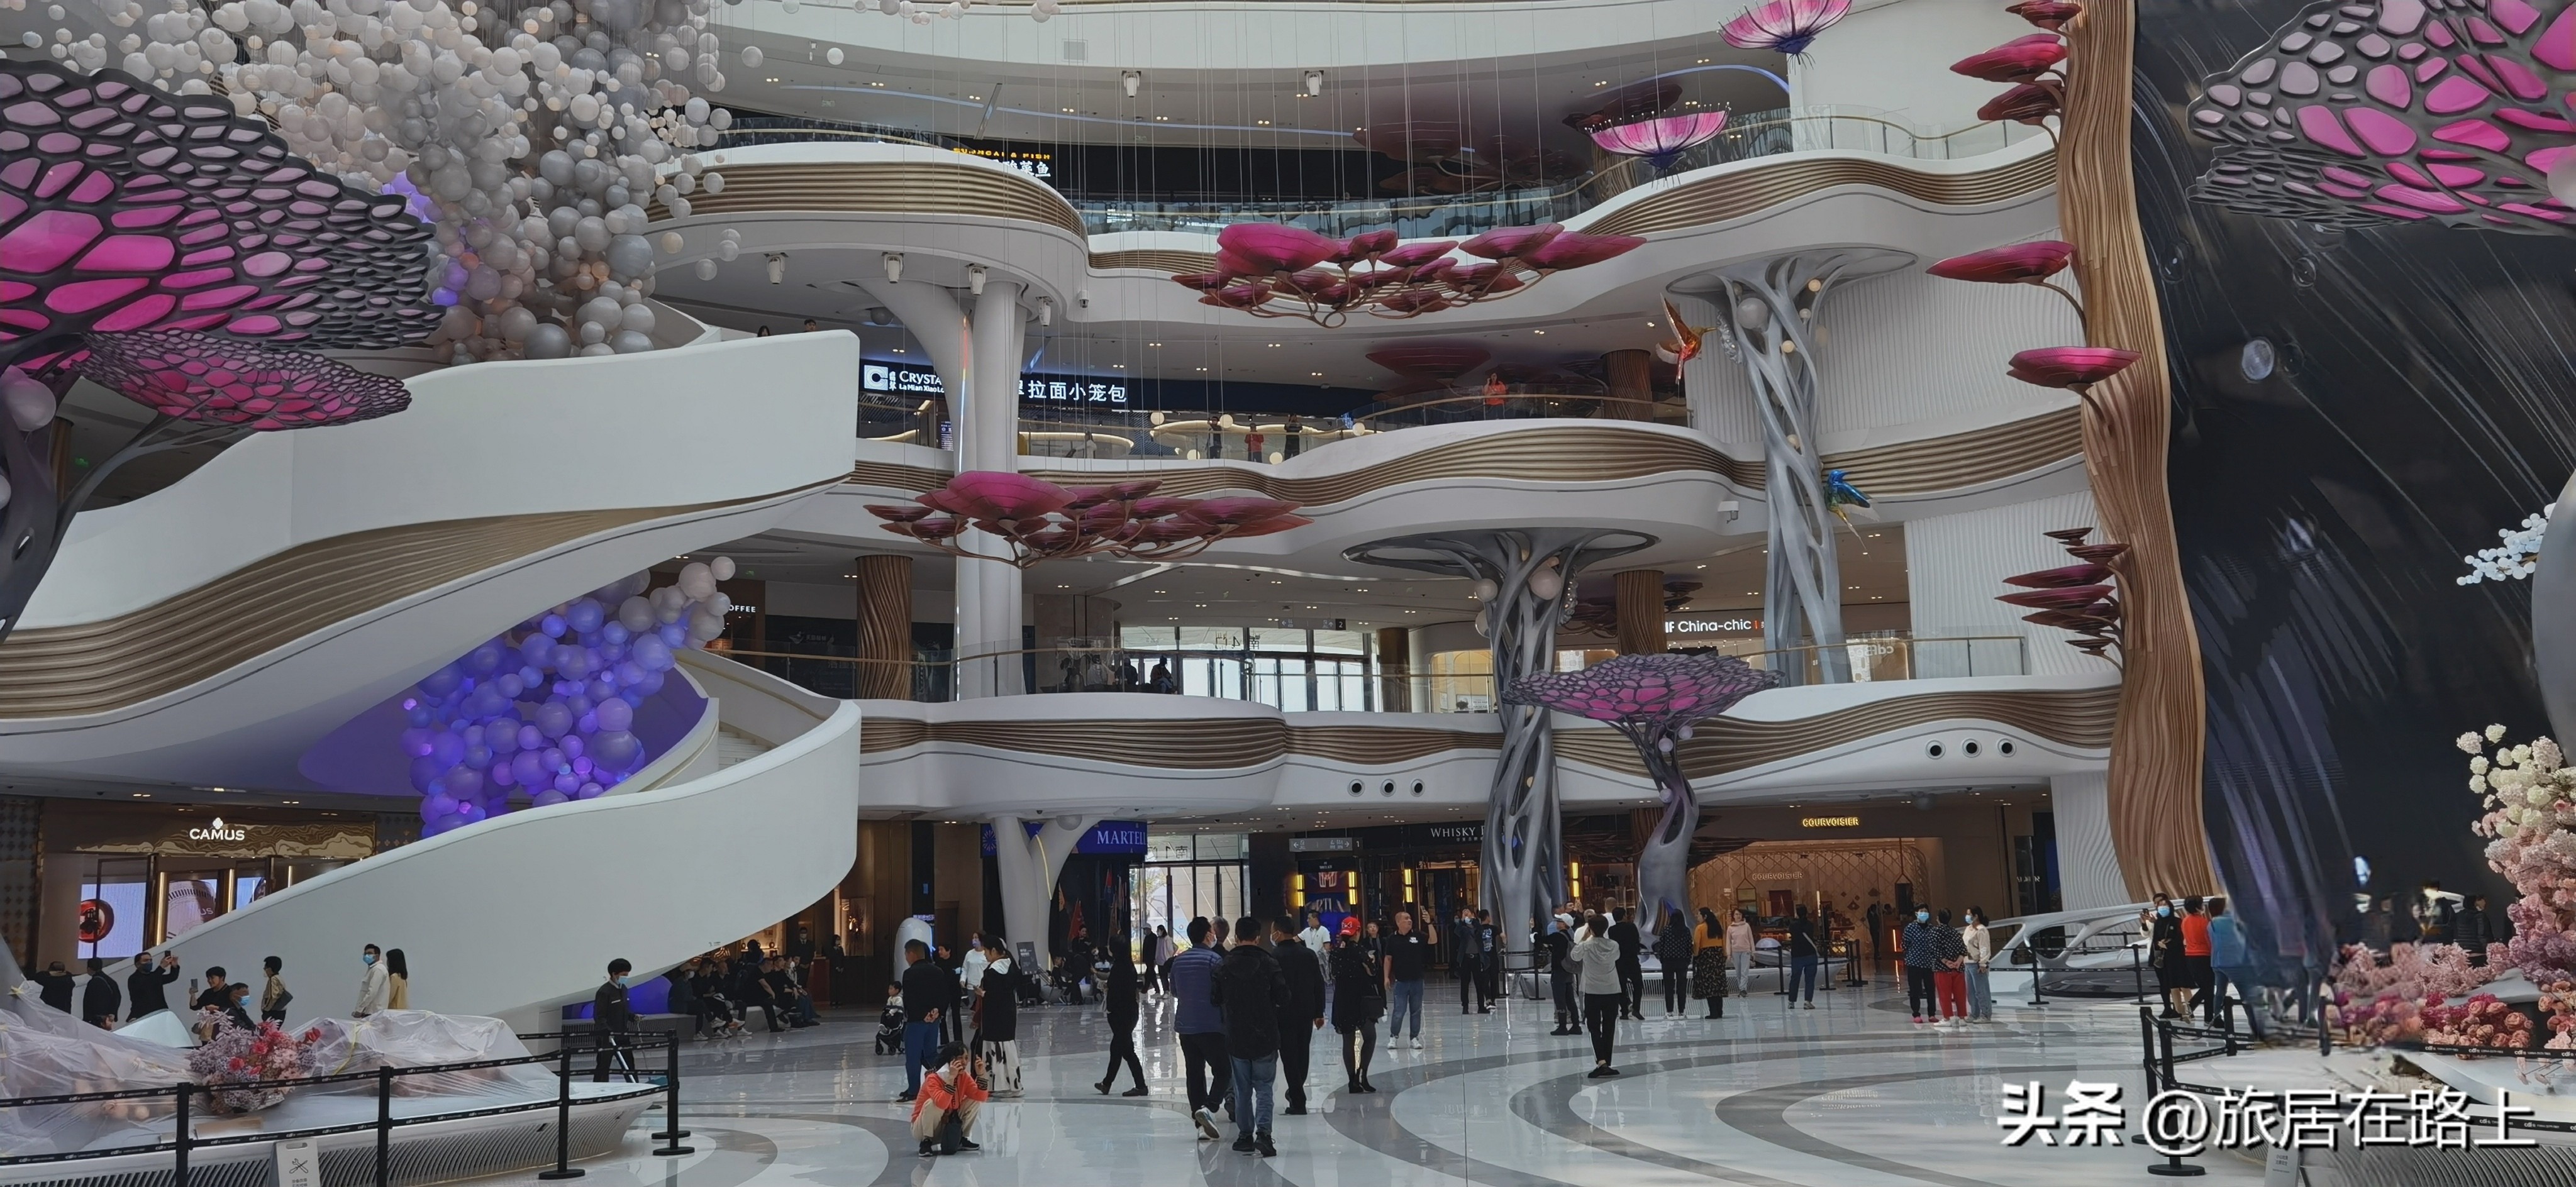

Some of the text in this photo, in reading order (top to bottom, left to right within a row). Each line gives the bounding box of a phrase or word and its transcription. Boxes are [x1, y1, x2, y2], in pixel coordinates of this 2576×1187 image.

[729, 604, 756, 612] OFFEE
[1678, 619, 1752, 632] China-chic
[1802, 817, 1859, 827] COURVOISIER
[189, 828, 245, 841] CAMUS
[1097, 831, 1146, 845] MARTELL
[1430, 827, 1475, 838] WHISKY
[1752, 871, 1804, 880] COURVOISIER
